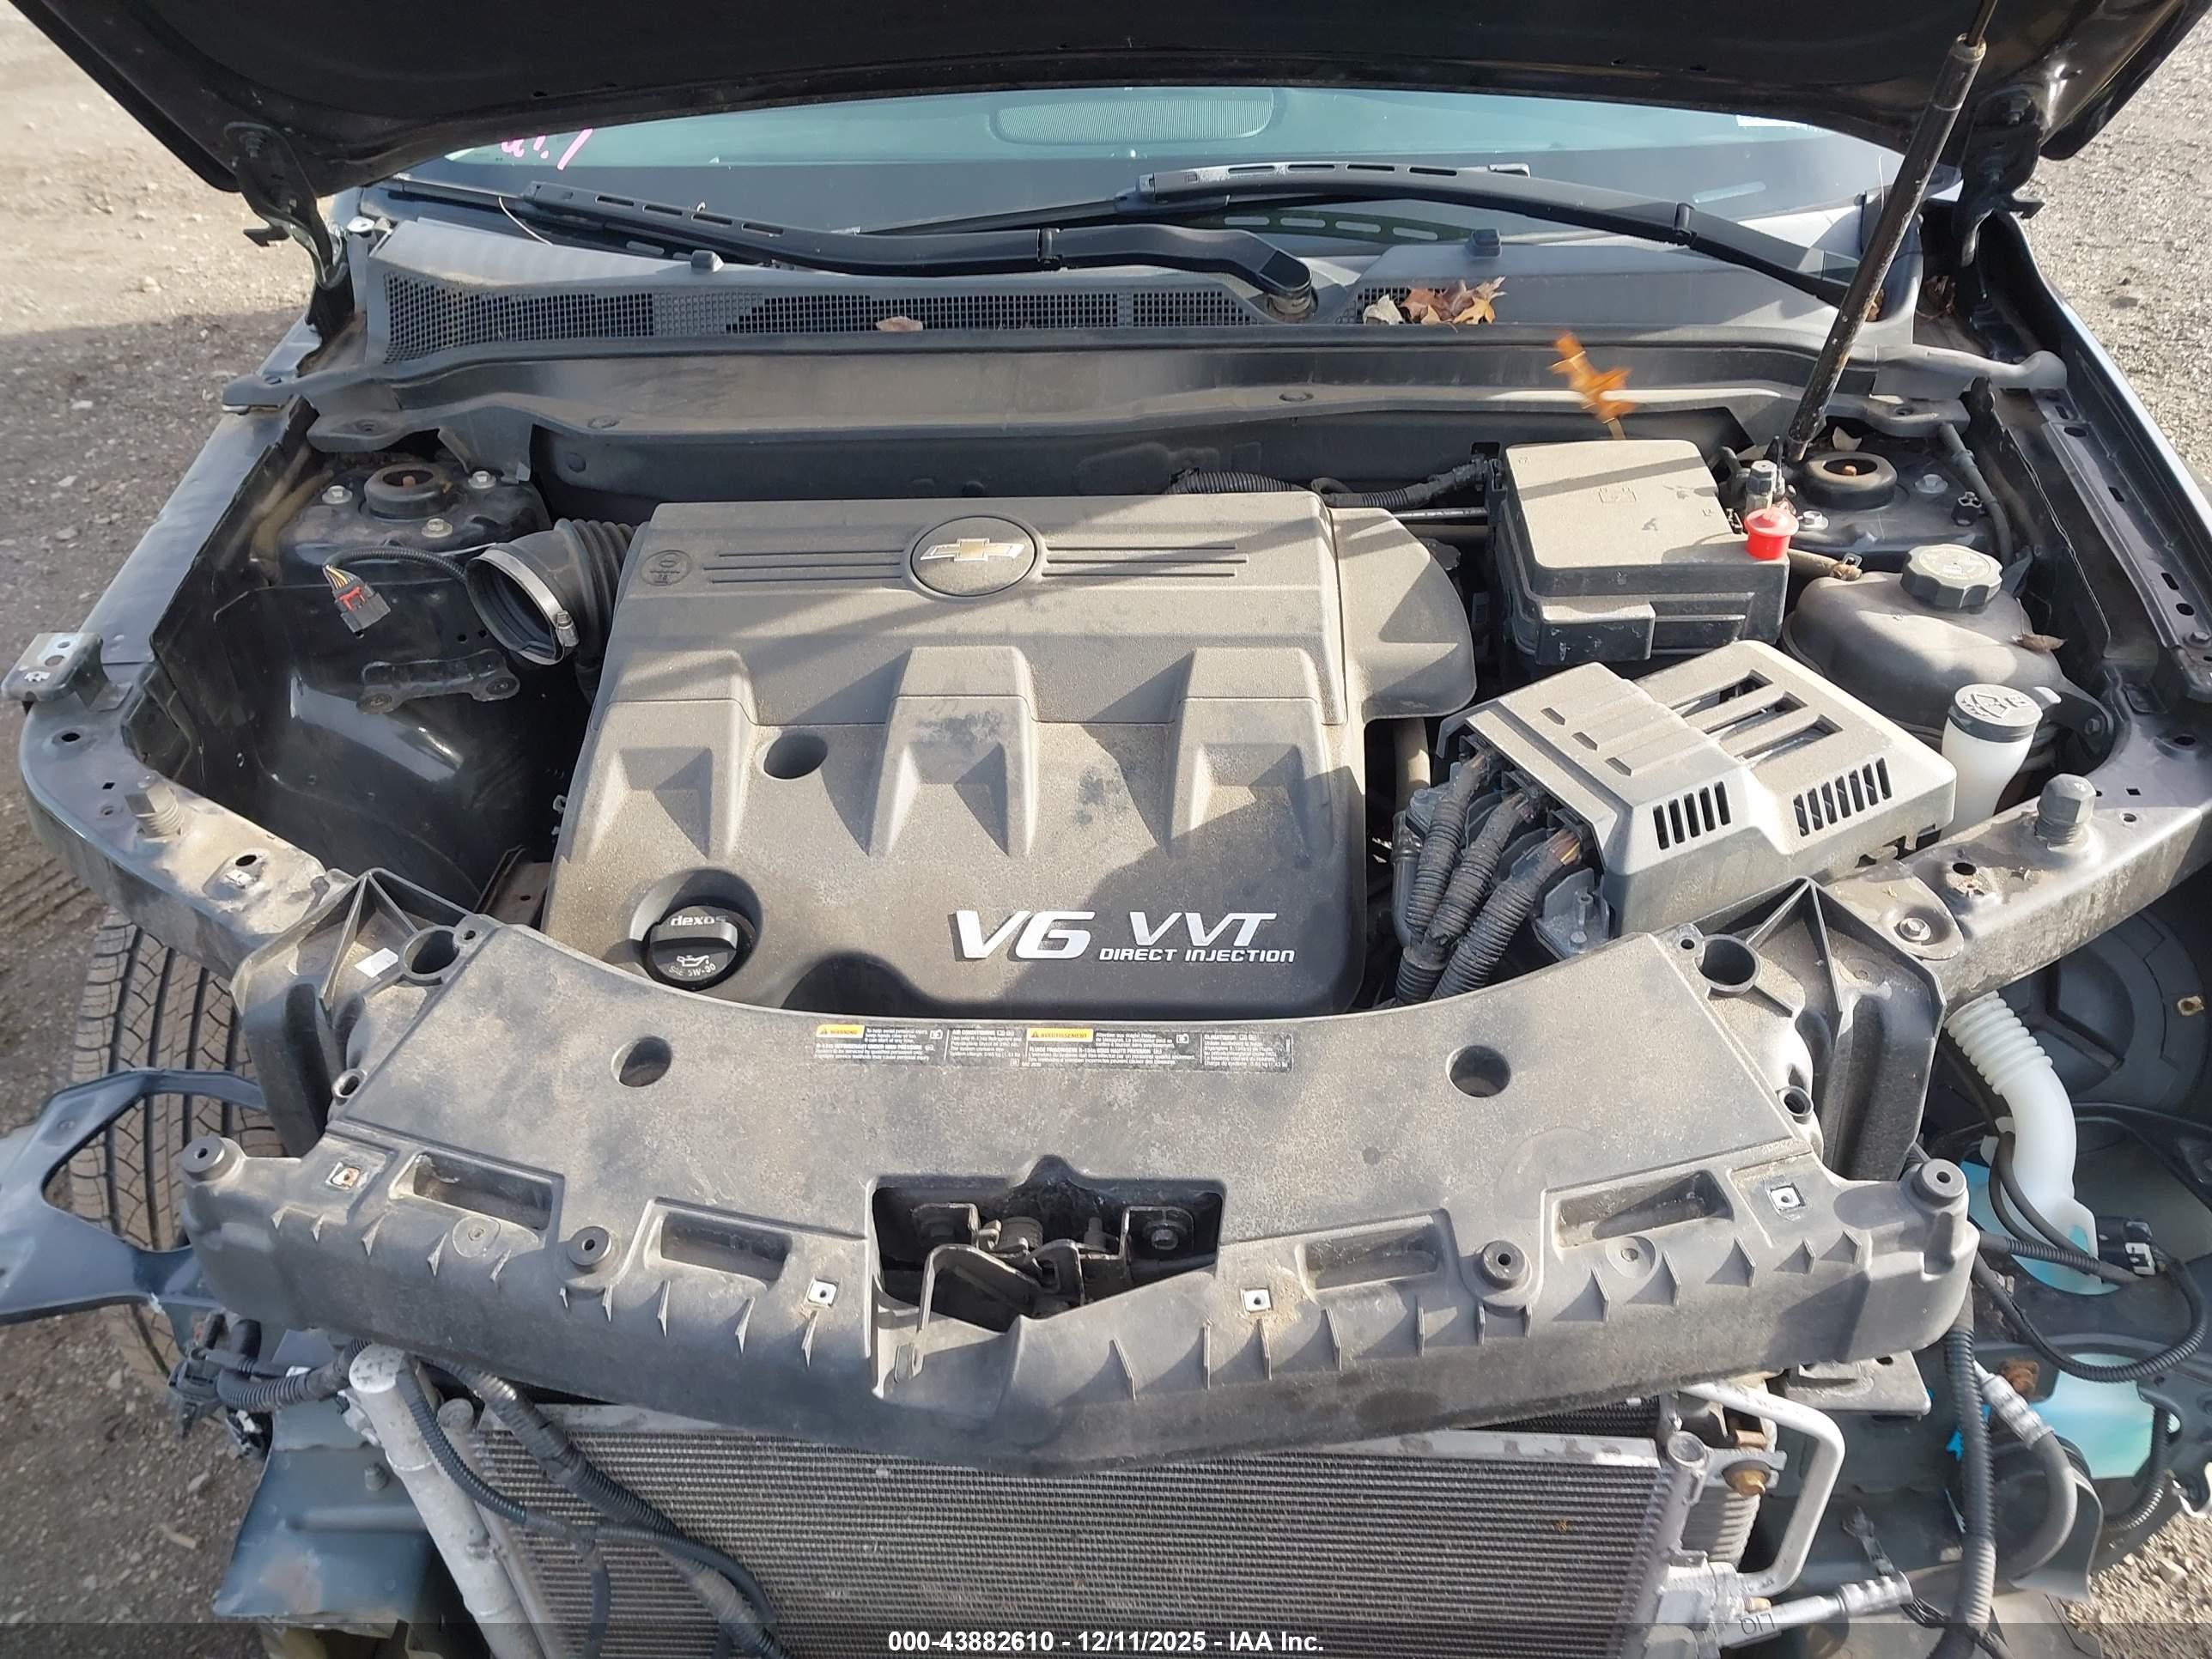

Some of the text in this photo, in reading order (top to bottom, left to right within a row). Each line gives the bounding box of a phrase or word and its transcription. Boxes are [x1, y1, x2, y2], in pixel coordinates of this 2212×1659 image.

[671, 915, 728, 926] dexos
[956, 910, 1278, 959] V6 VVT
[1099, 948, 1295, 963] DIRECT INJECTION
[688, 963, 716, 977] 5W-30
